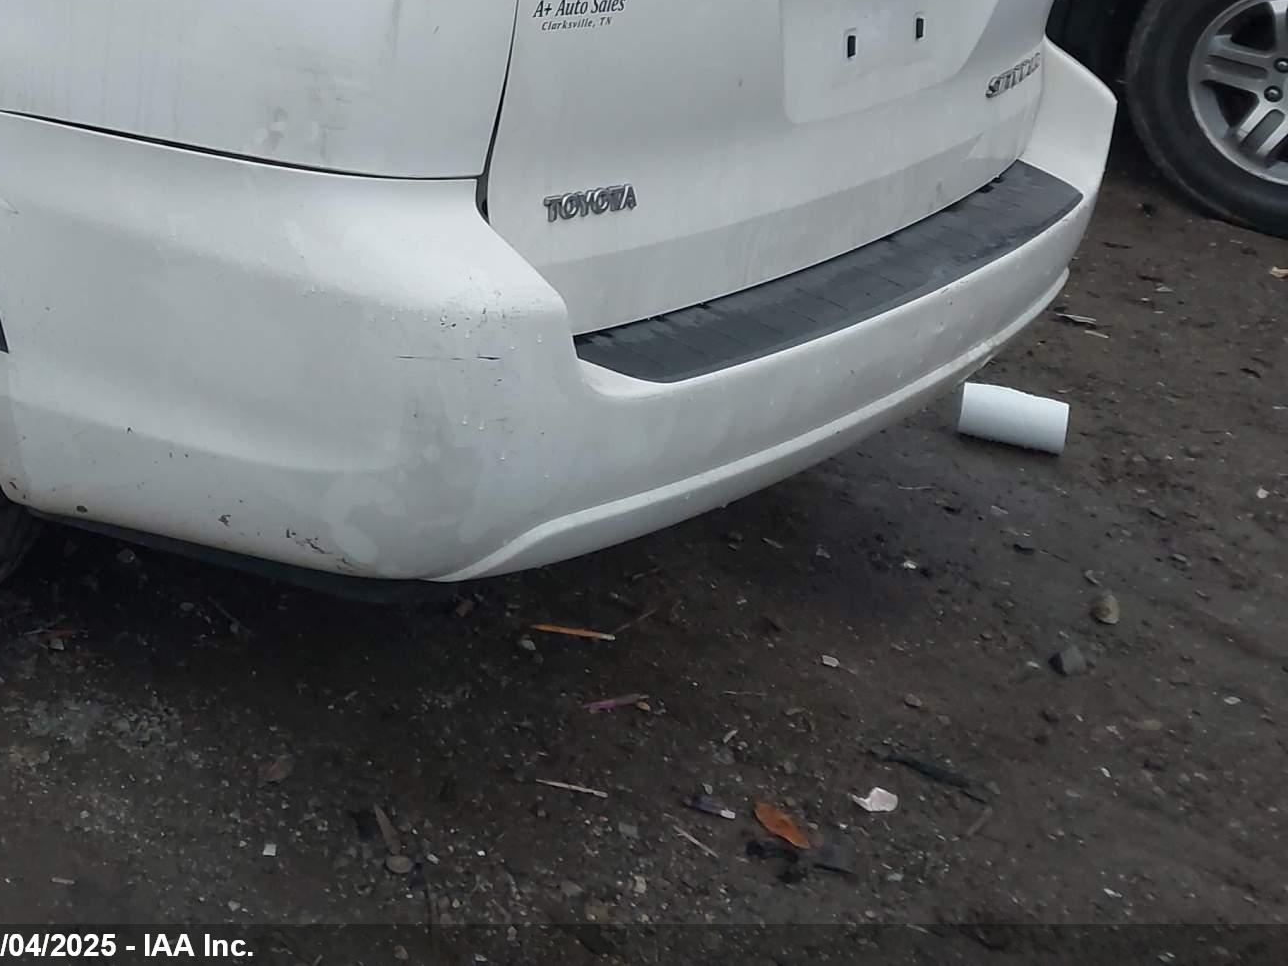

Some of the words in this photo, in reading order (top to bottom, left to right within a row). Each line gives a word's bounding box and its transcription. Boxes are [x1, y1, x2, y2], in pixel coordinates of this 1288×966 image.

[532, 0, 552, 18] A+
[541, 18, 595, 31] Clarksville,
[599, 17, 613, 26] TN
[543, 184, 637, 223] TOYOTA
